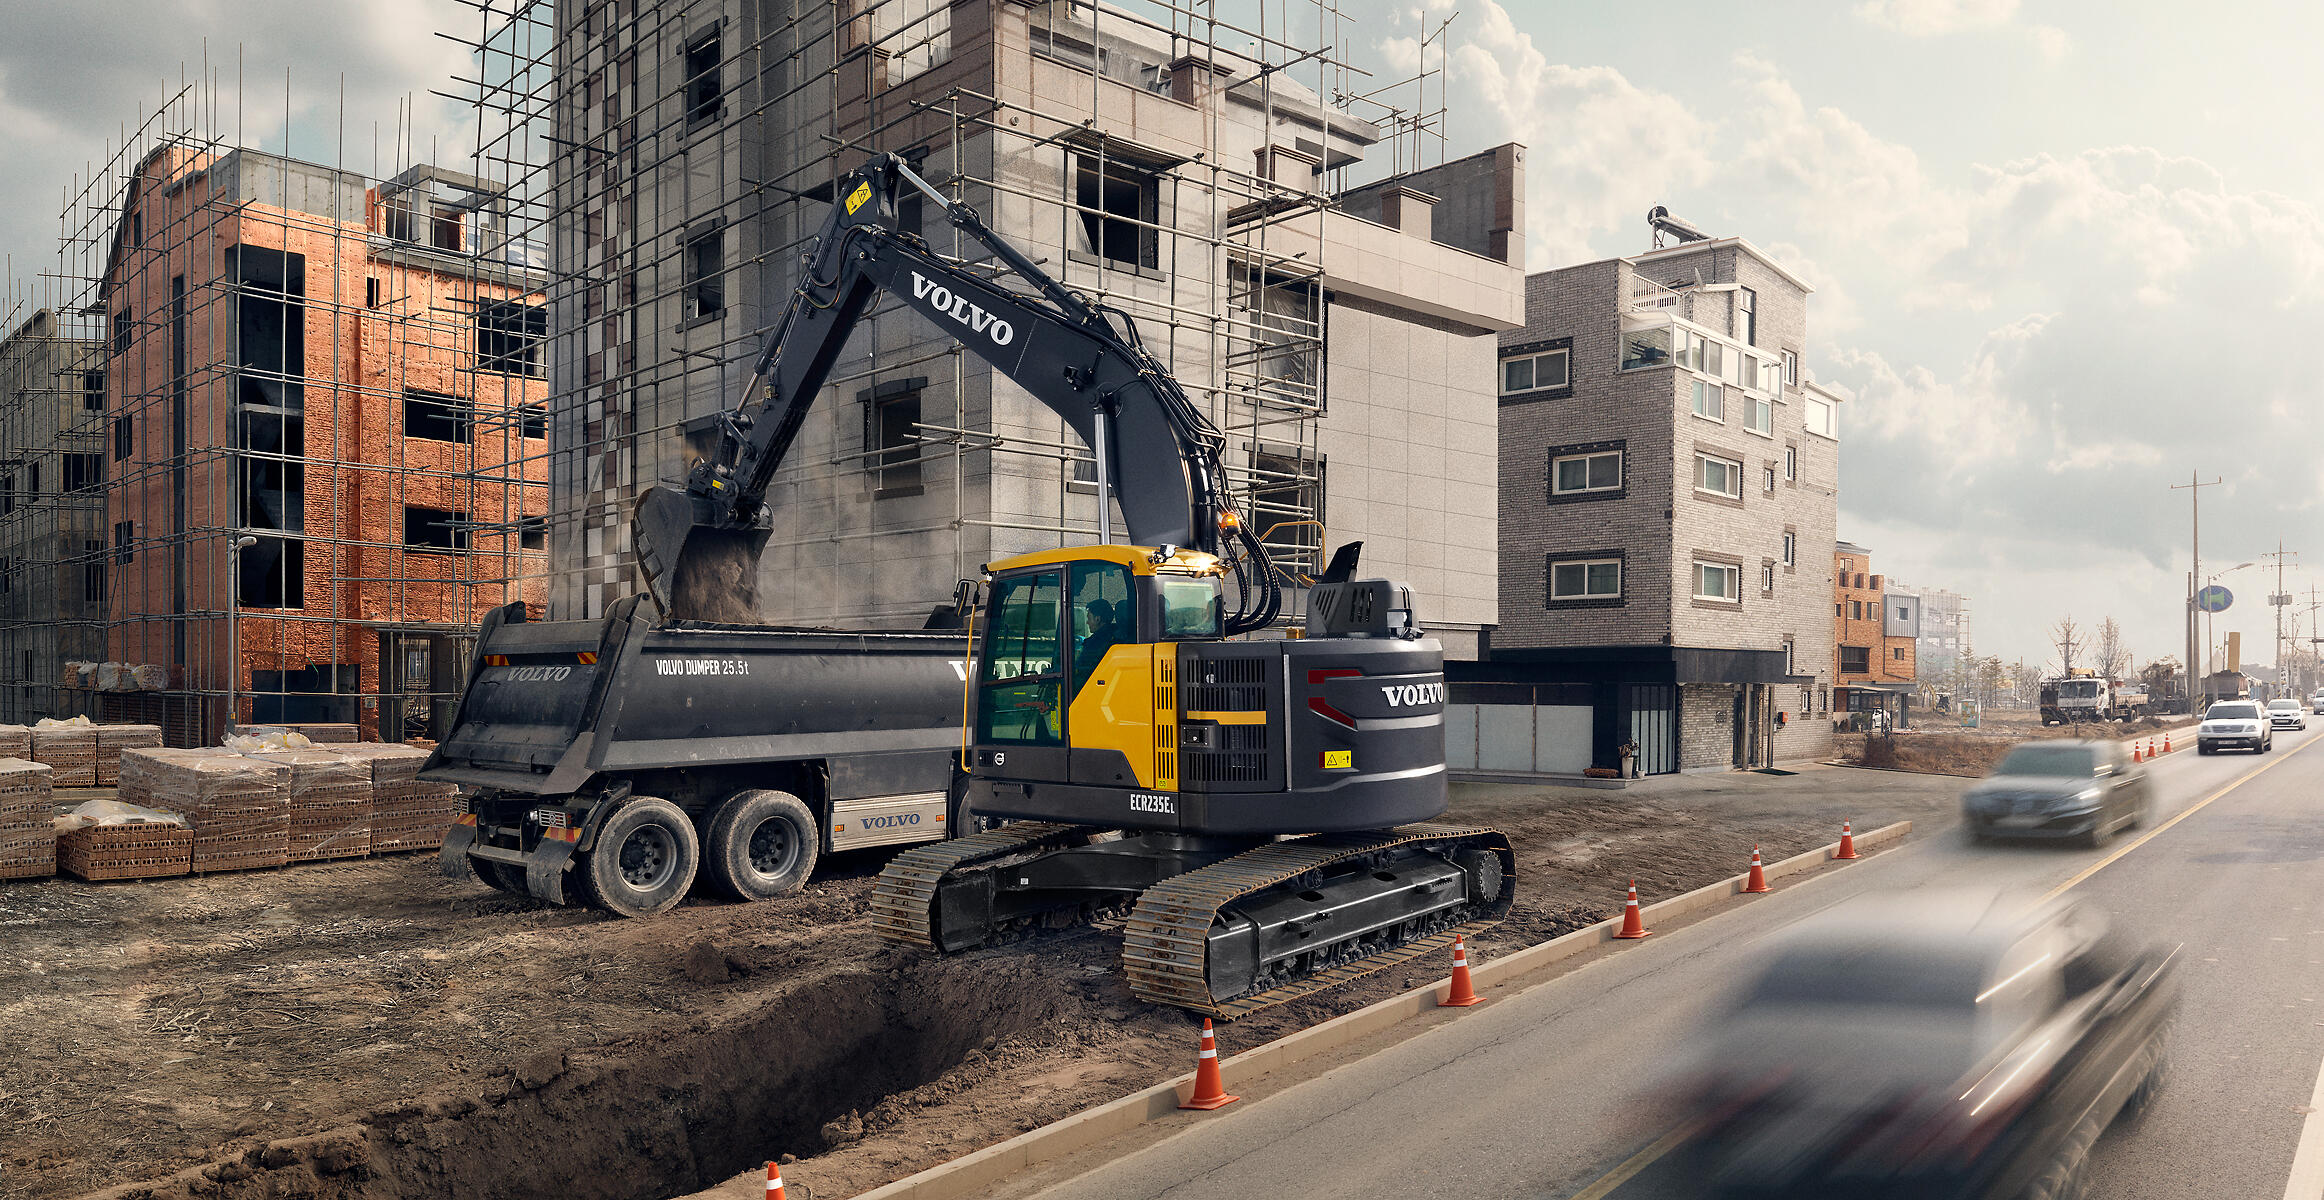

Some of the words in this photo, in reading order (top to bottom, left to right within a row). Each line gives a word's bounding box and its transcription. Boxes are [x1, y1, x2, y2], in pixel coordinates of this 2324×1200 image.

[911, 271, 1014, 346] VOLVO
[507, 666, 572, 682] VOLVO
[655, 659, 684, 676] VOLVO
[685, 659, 721, 676] DUMPER
[948, 660, 1053, 682] VLVO
[1381, 682, 1444, 707] VOLVO
[860, 813, 921, 830] VOLVO
